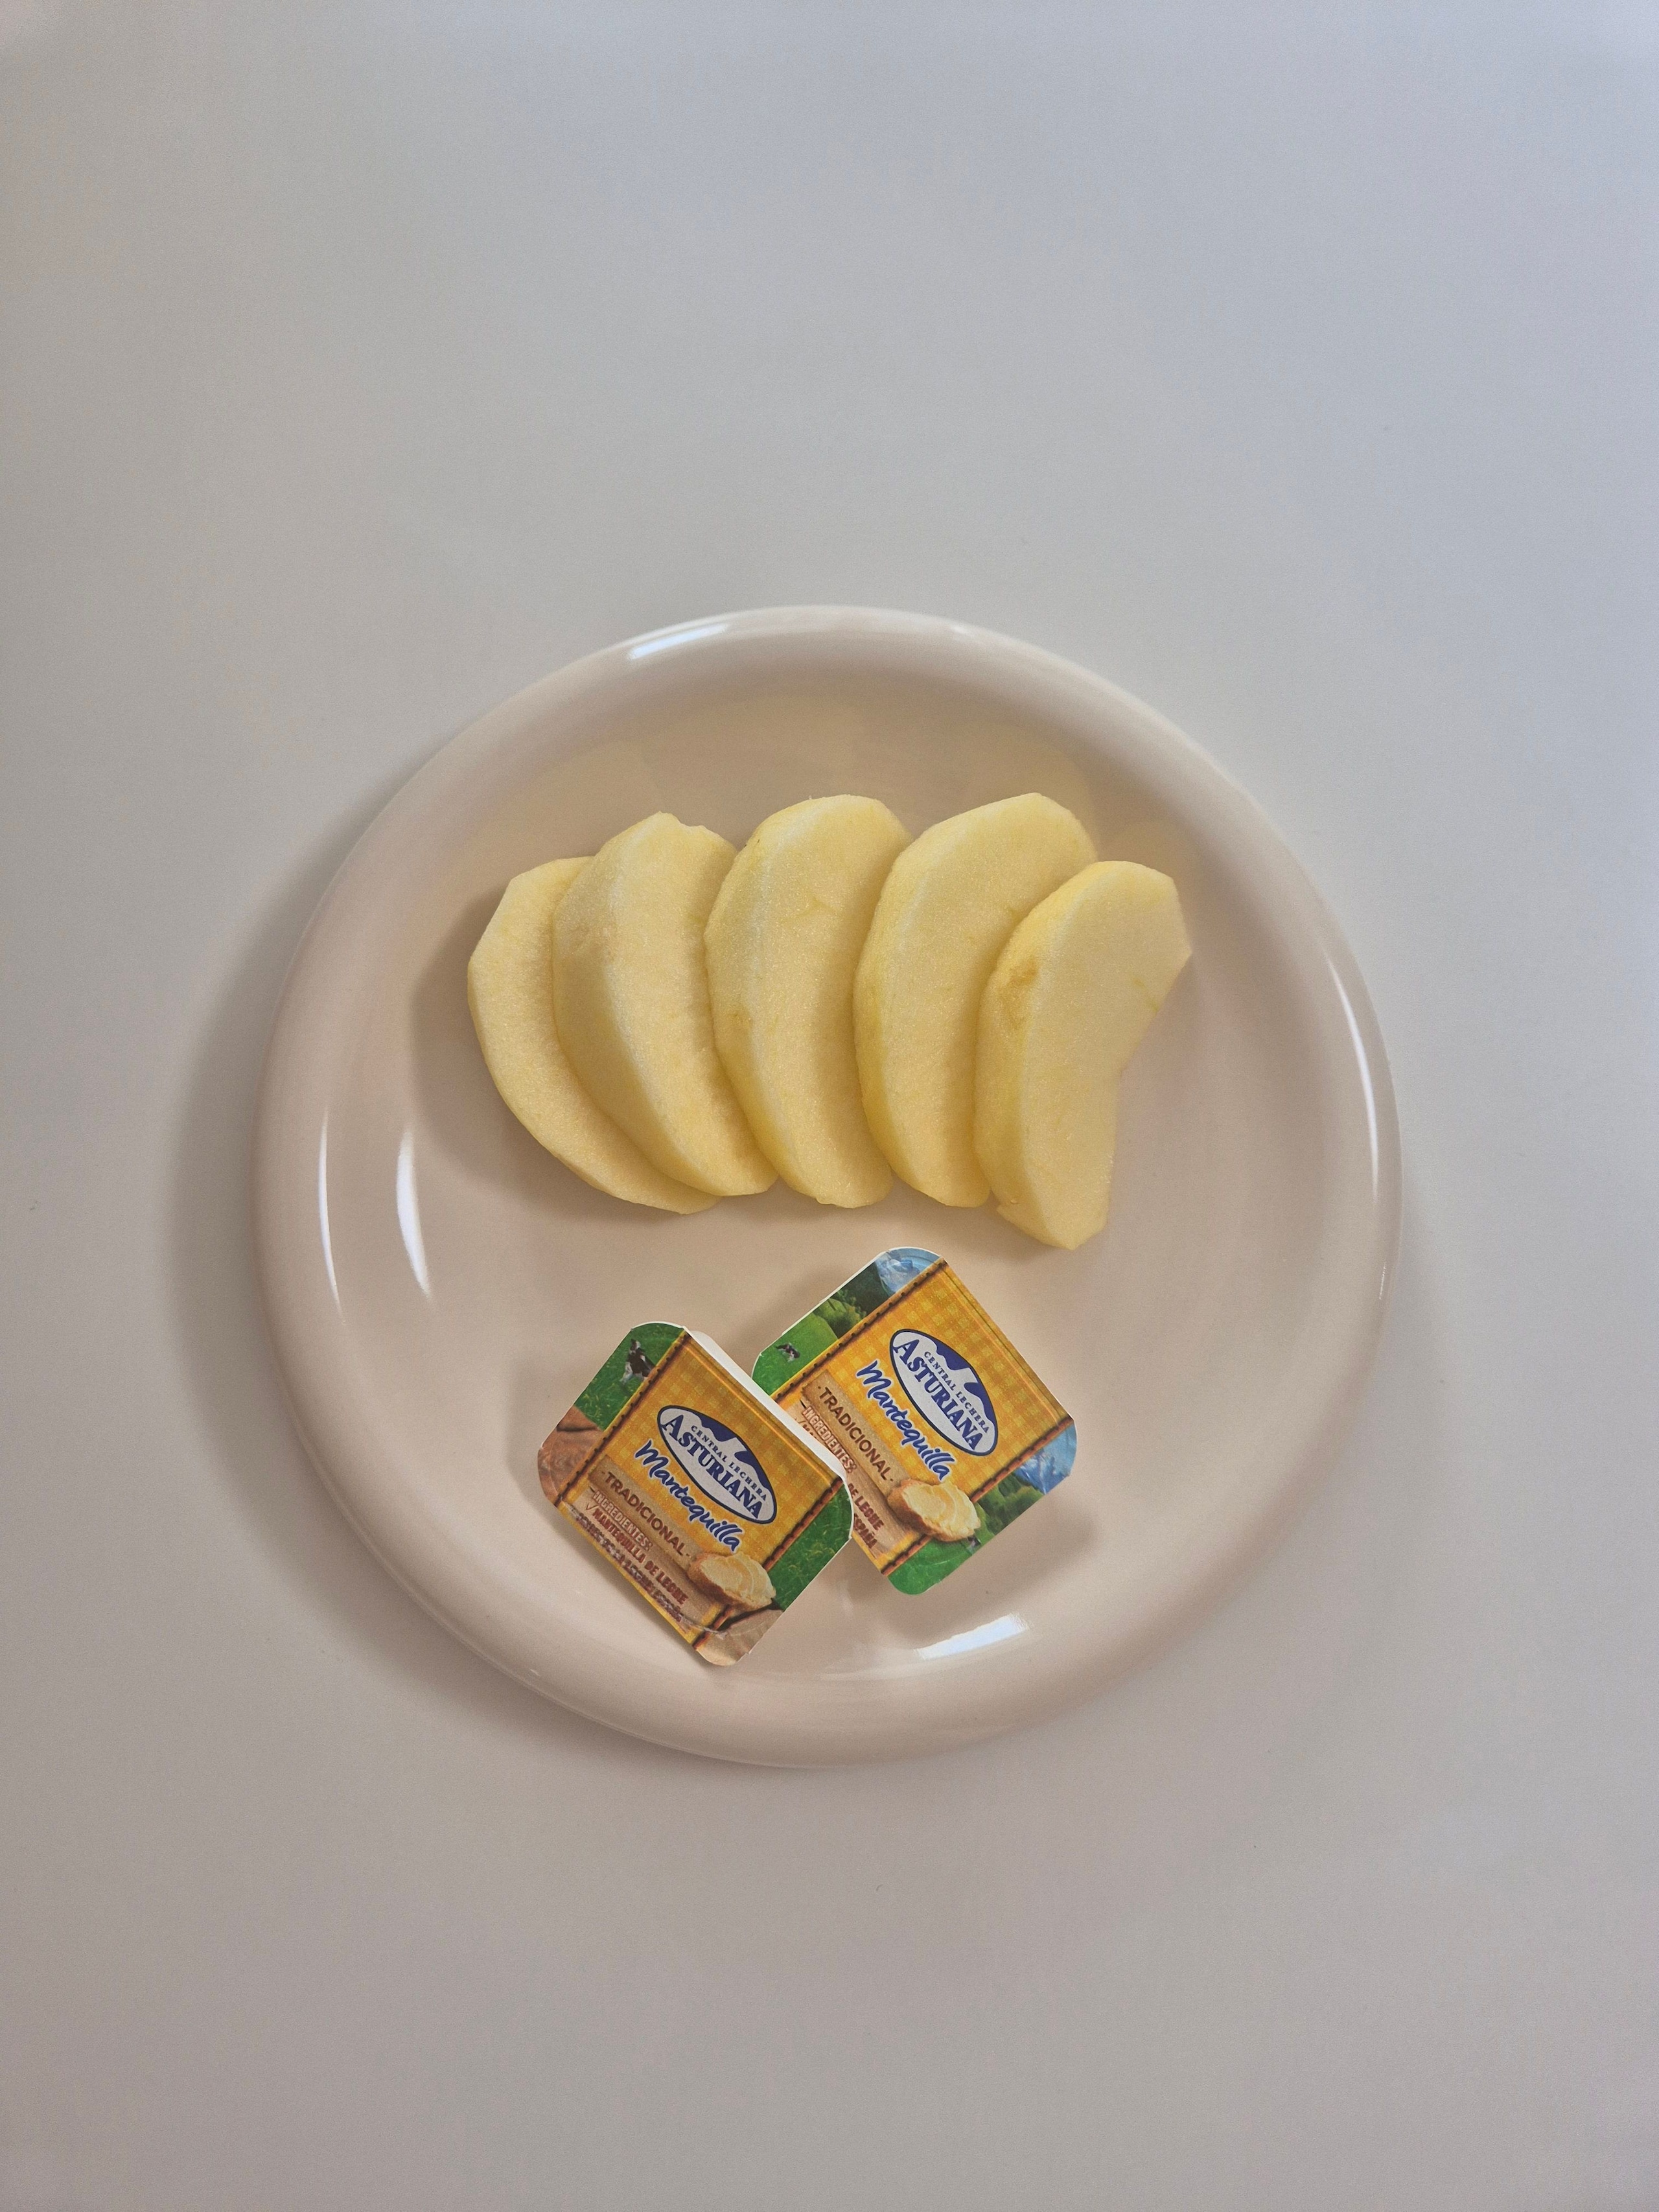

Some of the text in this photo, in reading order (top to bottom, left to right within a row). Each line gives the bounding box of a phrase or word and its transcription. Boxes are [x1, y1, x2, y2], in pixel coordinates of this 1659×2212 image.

[818, 1386, 892, 1481] TRADICIONAL
[856, 1360, 955, 1481] Mantequilla
[892, 1338, 983, 1450] ASTURIANA
[923, 1351, 990, 1434] CENTRAL LECHERA
[660, 1414, 763, 1519] ASTURIANA
[691, 1425, 768, 1502] CENTRAL LECHERA
[801, 1405, 857, 1474] INGREDIENTES:
[592, 1491, 654, 1551] INGREDIENTES:
[605, 1471, 687, 1557] TRADICIONAL
[634, 1439, 743, 1552] Mantequilla
[854, 1495, 885, 1531] LECHE
[644, 1560, 659, 1576] DE
